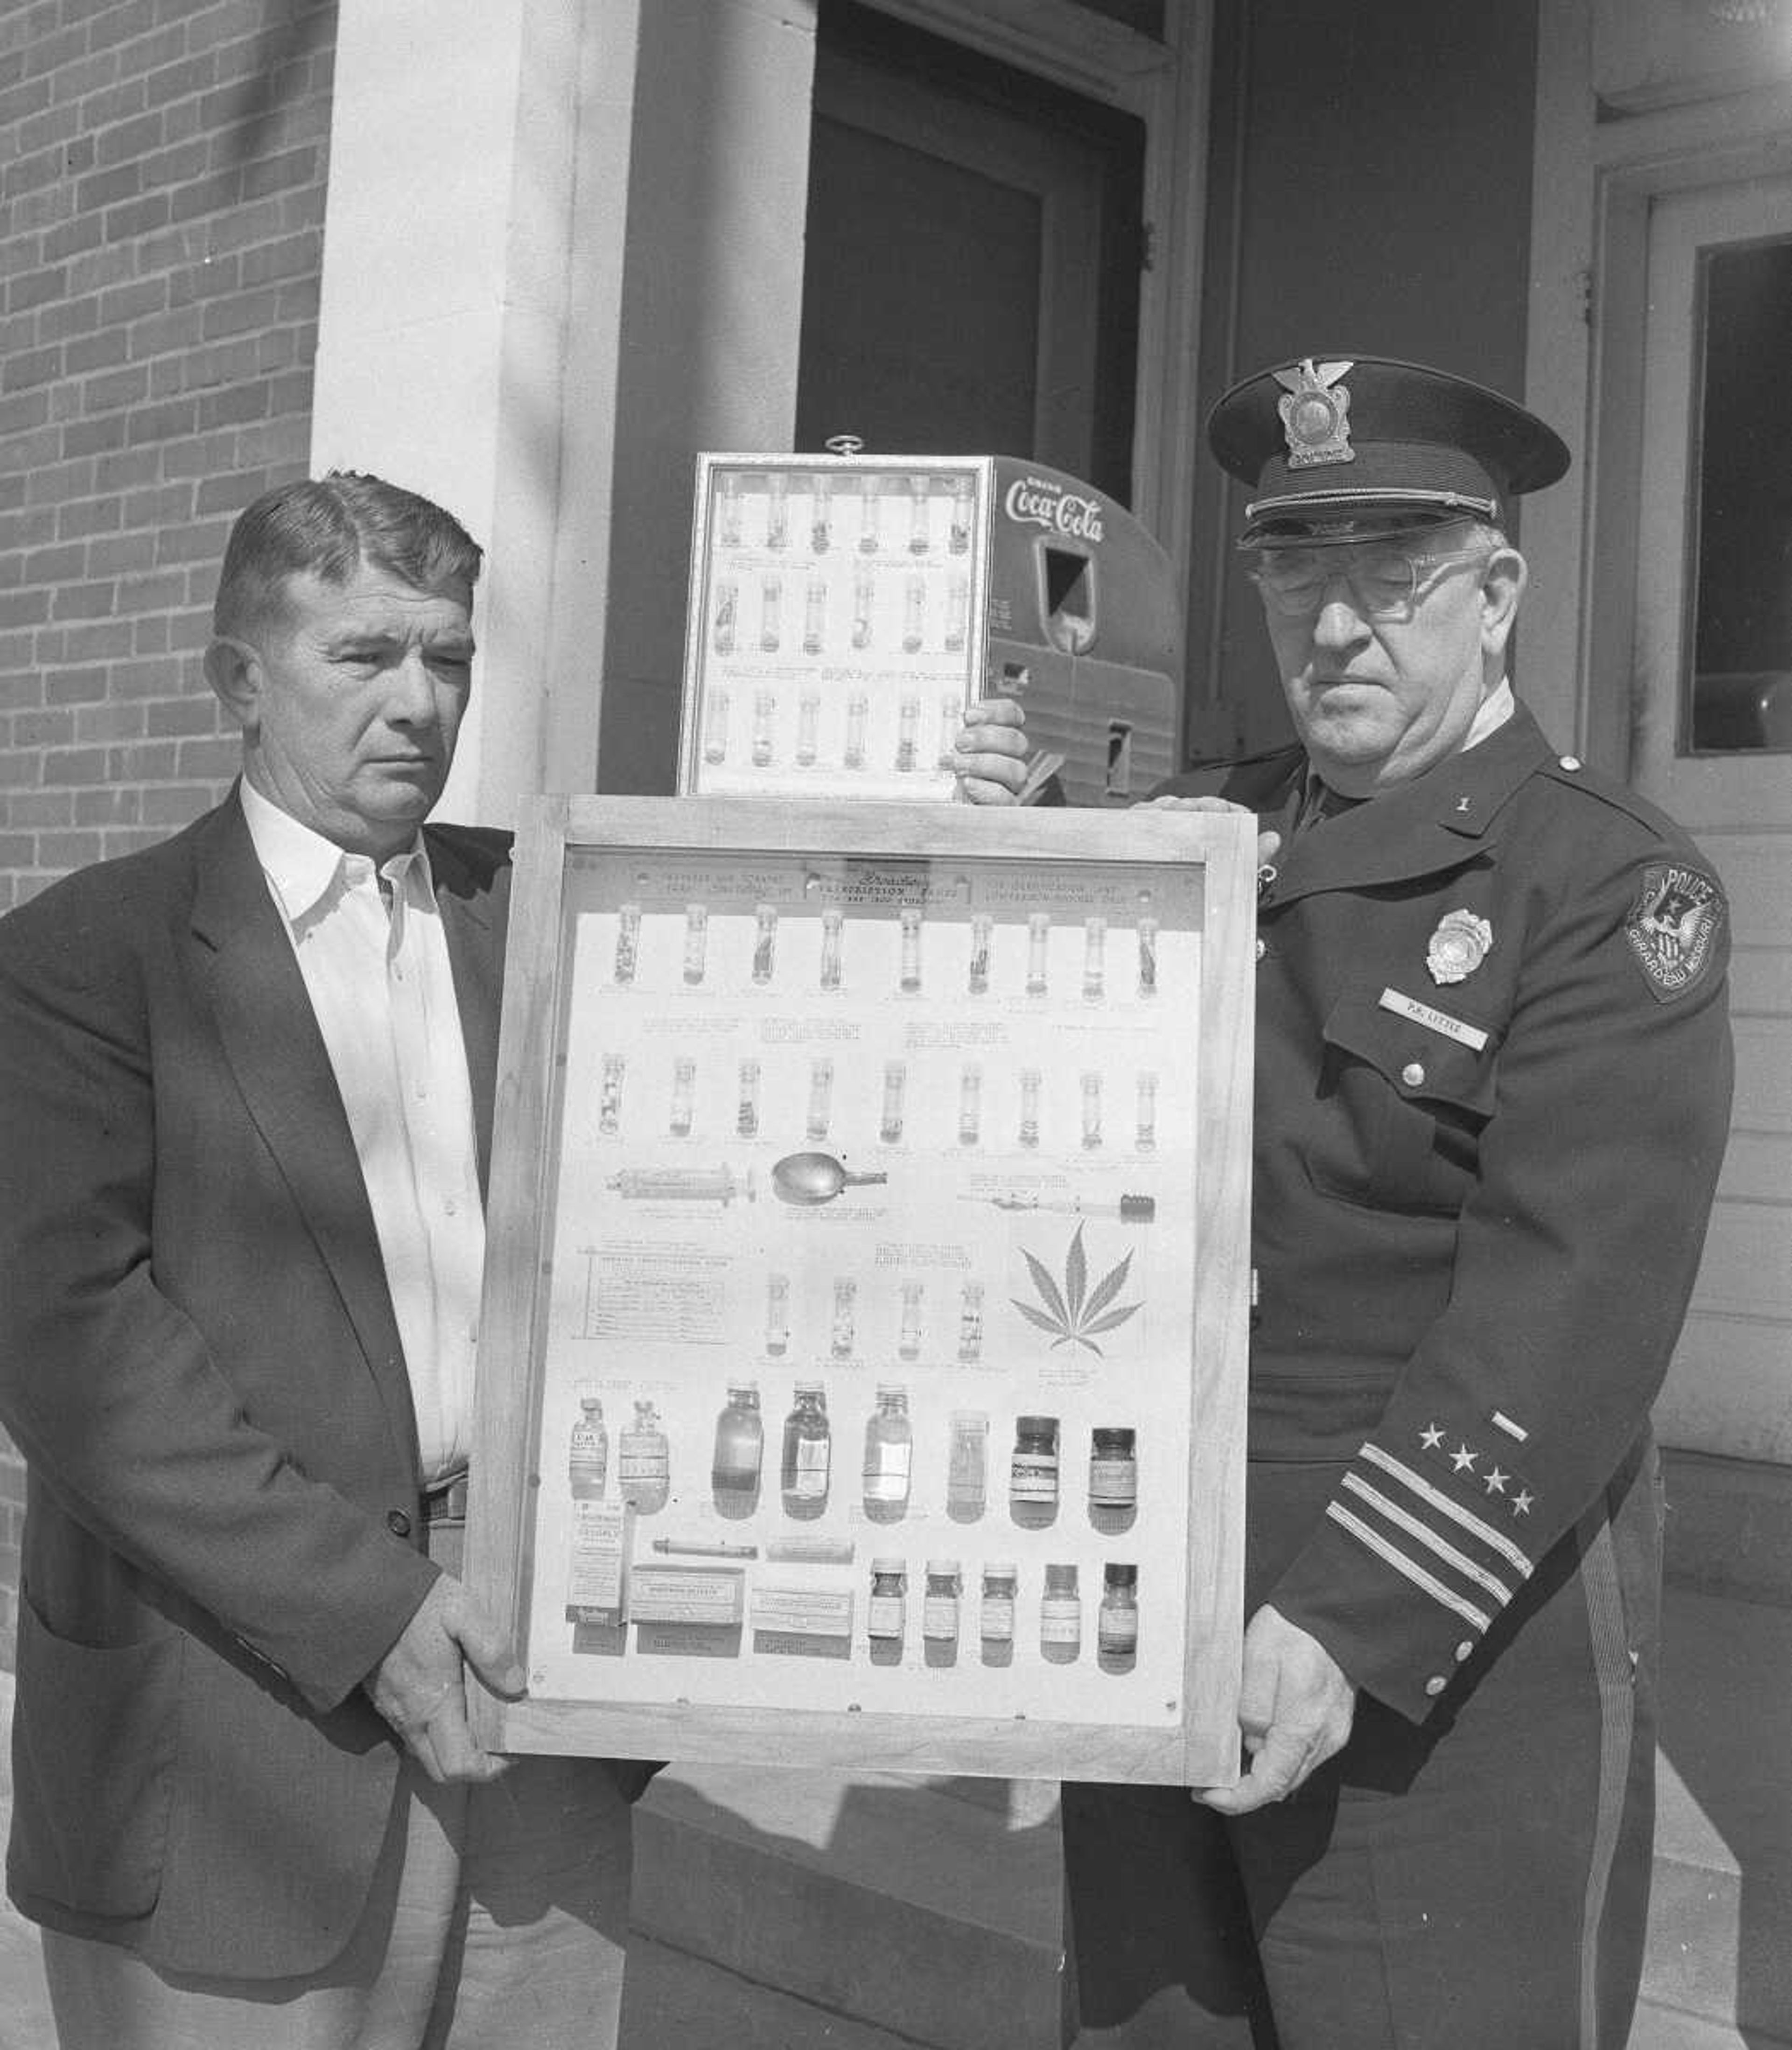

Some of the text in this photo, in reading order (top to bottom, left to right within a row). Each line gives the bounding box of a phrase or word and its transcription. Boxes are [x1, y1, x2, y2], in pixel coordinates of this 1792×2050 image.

[1006, 480, 1102, 542] Coca-Cola
[1666, 869, 1714, 903] POLICE
[1428, 1011, 1462, 1033] LITTLE
